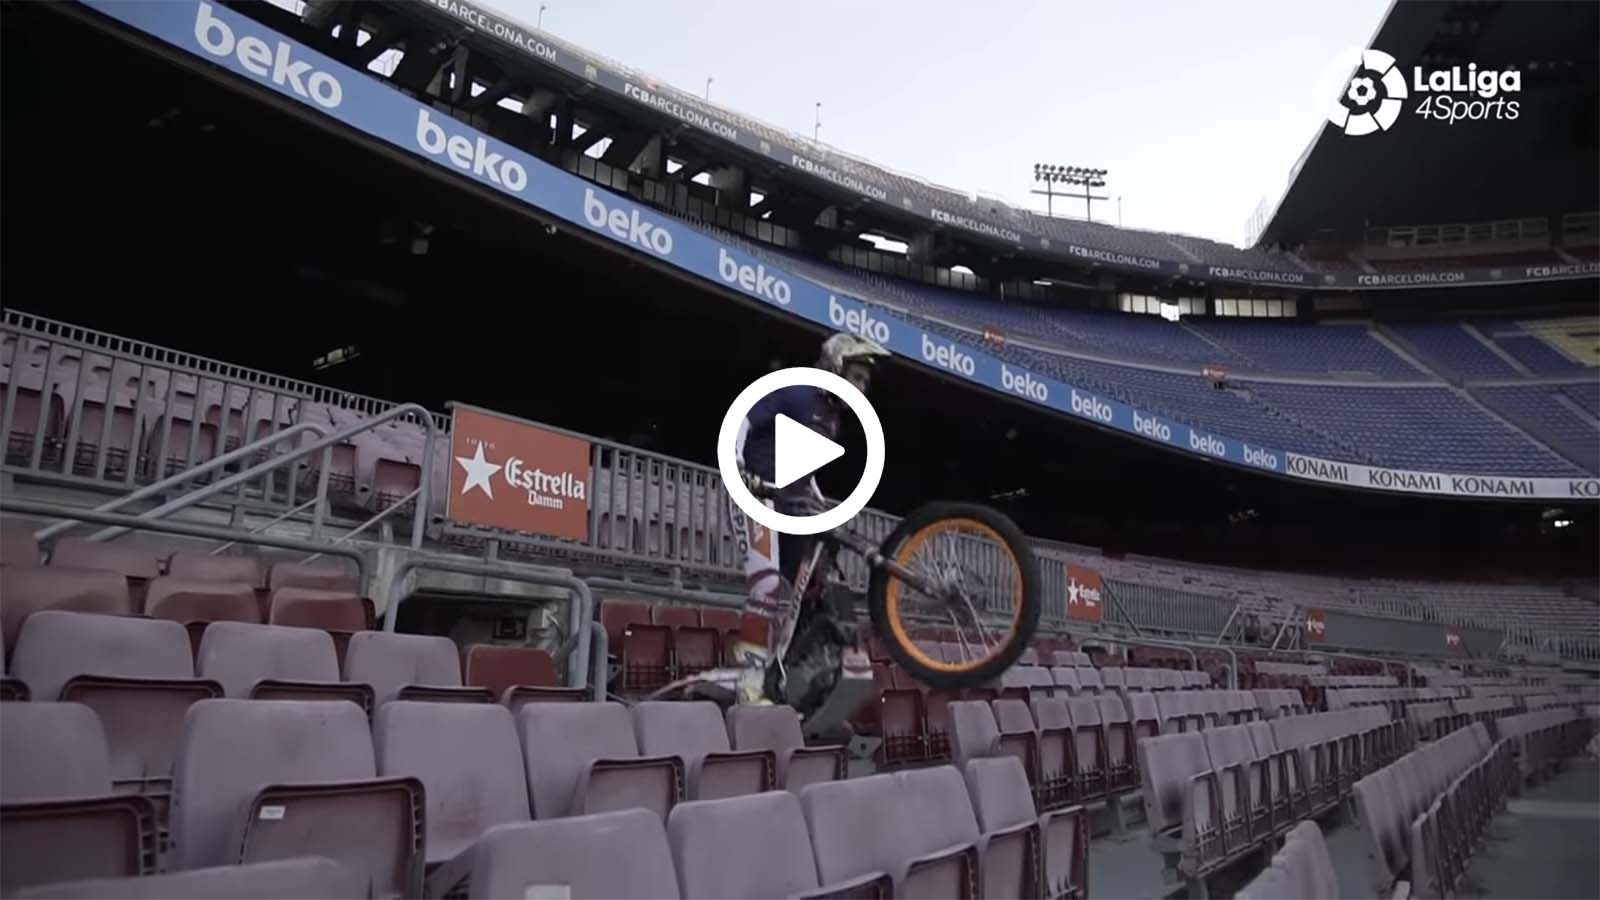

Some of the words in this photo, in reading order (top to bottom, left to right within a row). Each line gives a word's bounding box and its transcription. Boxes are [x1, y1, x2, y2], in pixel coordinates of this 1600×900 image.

[431, 0, 556, 62] BARCELONA.COM
[624, 83, 737, 139] FCBARCELONA.COM
[792, 155, 887, 200] FCBARCELONA.COM
[931, 208, 1020, 243] FCBARCELONA.COM
[1069, 245, 1160, 270] FCBARCELONA.COM
[1209, 266, 1303, 283] FCBARCELONA.COM
[1358, 272, 1464, 285] FCBARCELONA.COM
[194, 2, 343, 108] beko
[416, 109, 528, 192] beko
[584, 188, 673, 255] beko
[719, 248, 791, 305] beko
[829, 296, 889, 343] beko
[922, 335, 975, 376] beko
[1002, 365, 1048, 401] beko
[1071, 390, 1112, 422] beko
[1133, 411, 1170, 440] beko
[1190, 429, 1225, 456] beko
[1243, 444, 1277, 468] beko
[504, 456, 585, 500] Estrella
[1287, 454, 1349, 481] KONAMI
[1368, 469, 1441, 490] KONAMI
[1452, 477, 1535, 495] KONAMI
[528, 490, 563, 509] Damm
